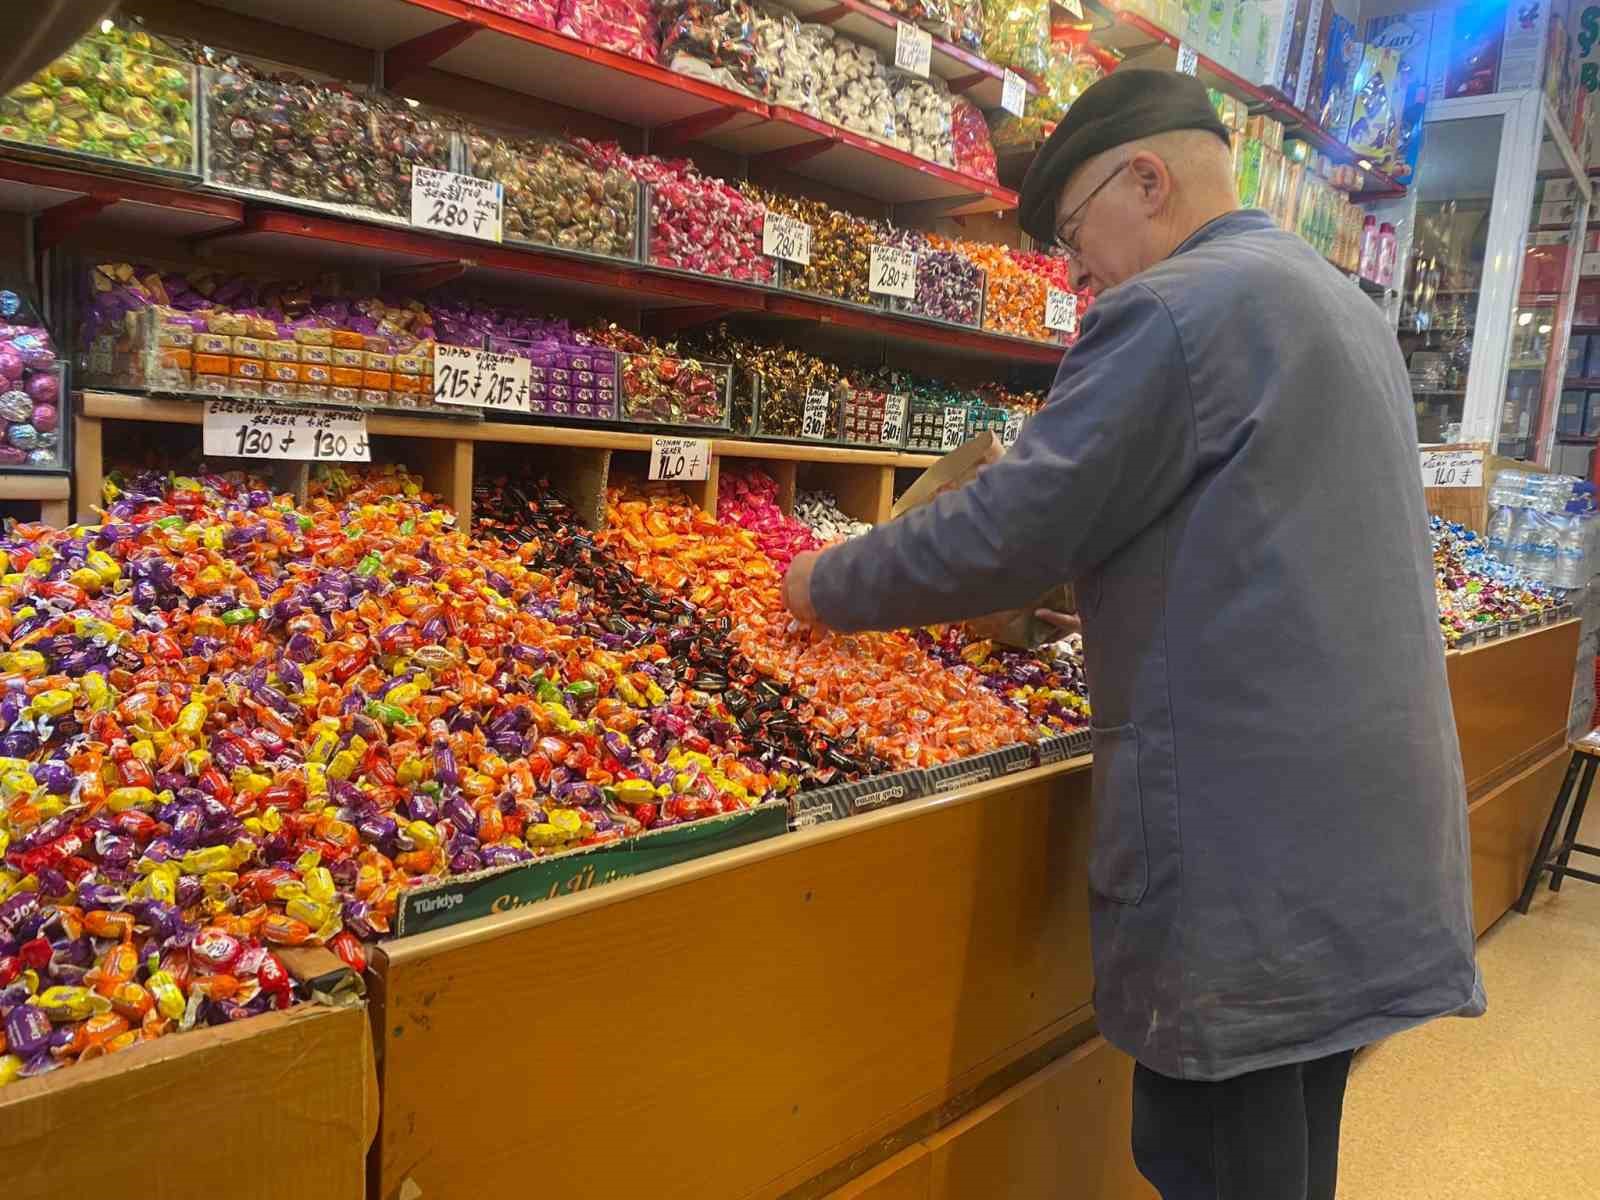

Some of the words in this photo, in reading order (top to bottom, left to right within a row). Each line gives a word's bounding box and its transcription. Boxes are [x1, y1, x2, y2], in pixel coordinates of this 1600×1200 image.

[427, 200, 469, 227] 280
[773, 232, 795, 257] 280
[877, 263, 900, 287] 280
[435, 365, 470, 398] 215
[485, 373, 515, 405] 215
[803, 415, 821, 435] 310
[944, 428, 959, 447] 310
[235, 425, 273, 455] 130
[313, 429, 348, 457] 130
